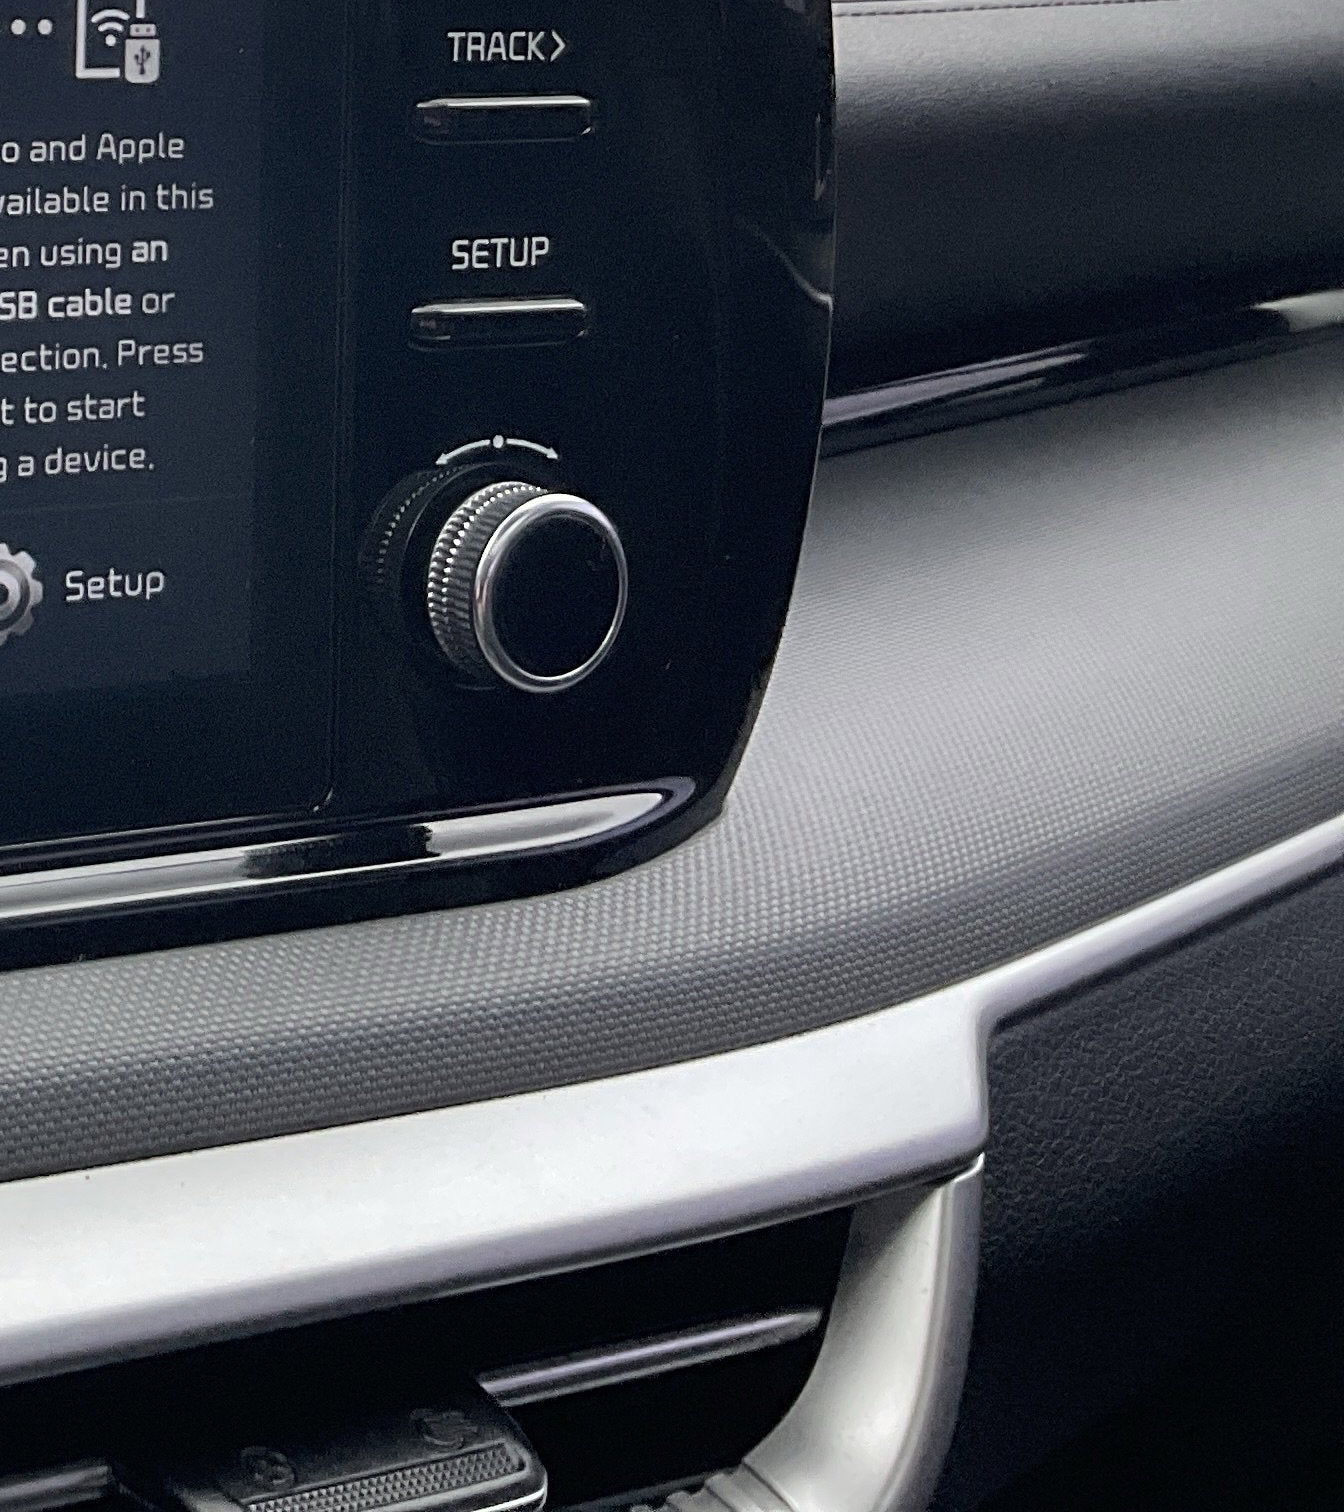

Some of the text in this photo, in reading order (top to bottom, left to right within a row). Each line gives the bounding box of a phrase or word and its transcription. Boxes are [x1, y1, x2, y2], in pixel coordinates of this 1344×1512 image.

[29, 134, 86, 163] and
[96, 132, 184, 165] Apple
[121, 183, 146, 211] in
[156, 183, 214, 211] this
[40, 237, 122, 269] using
[131, 240, 168, 263] an
[451, 236, 550, 270] SETUP
[47, 287, 132, 318] cable
[141, 292, 176, 314] or
[117, 339, 204, 367] Press
[24, 396, 57, 424] to
[67, 390, 145, 421] start
[17, 455, 35, 477] a
[44, 443, 156, 475] device.
[65, 567, 165, 602] Setup
